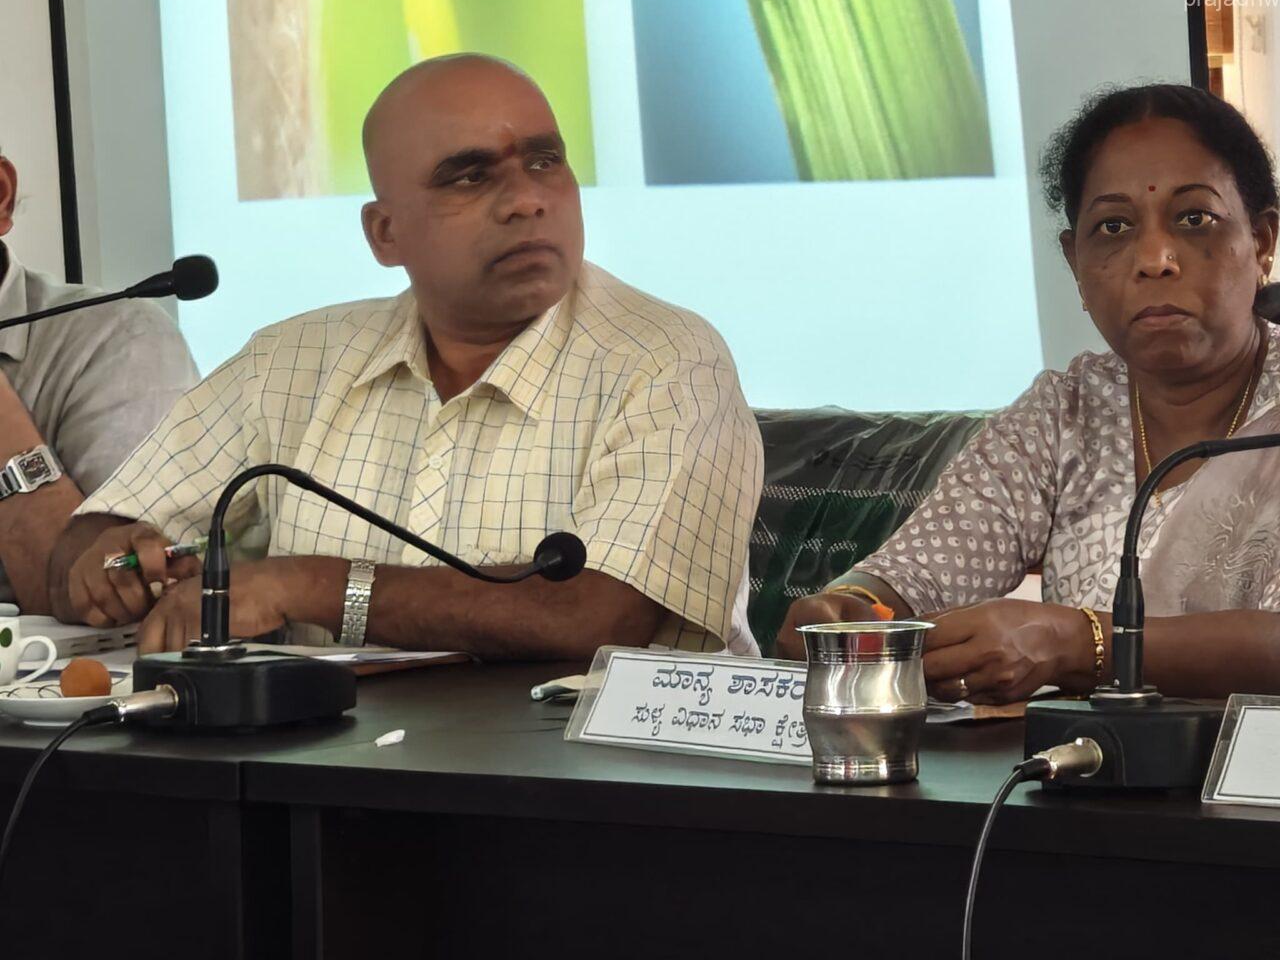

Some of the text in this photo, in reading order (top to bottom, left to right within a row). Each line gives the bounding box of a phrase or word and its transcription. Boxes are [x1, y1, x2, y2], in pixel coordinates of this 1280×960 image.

[653, 664, 715, 706] ಮಾನ್ಯ
[630, 703, 667, 737] ಸುಳ್ಯ
[671, 706, 725, 732] ವಿಧಾನ
[728, 710, 766, 735] ಸಭಾ
